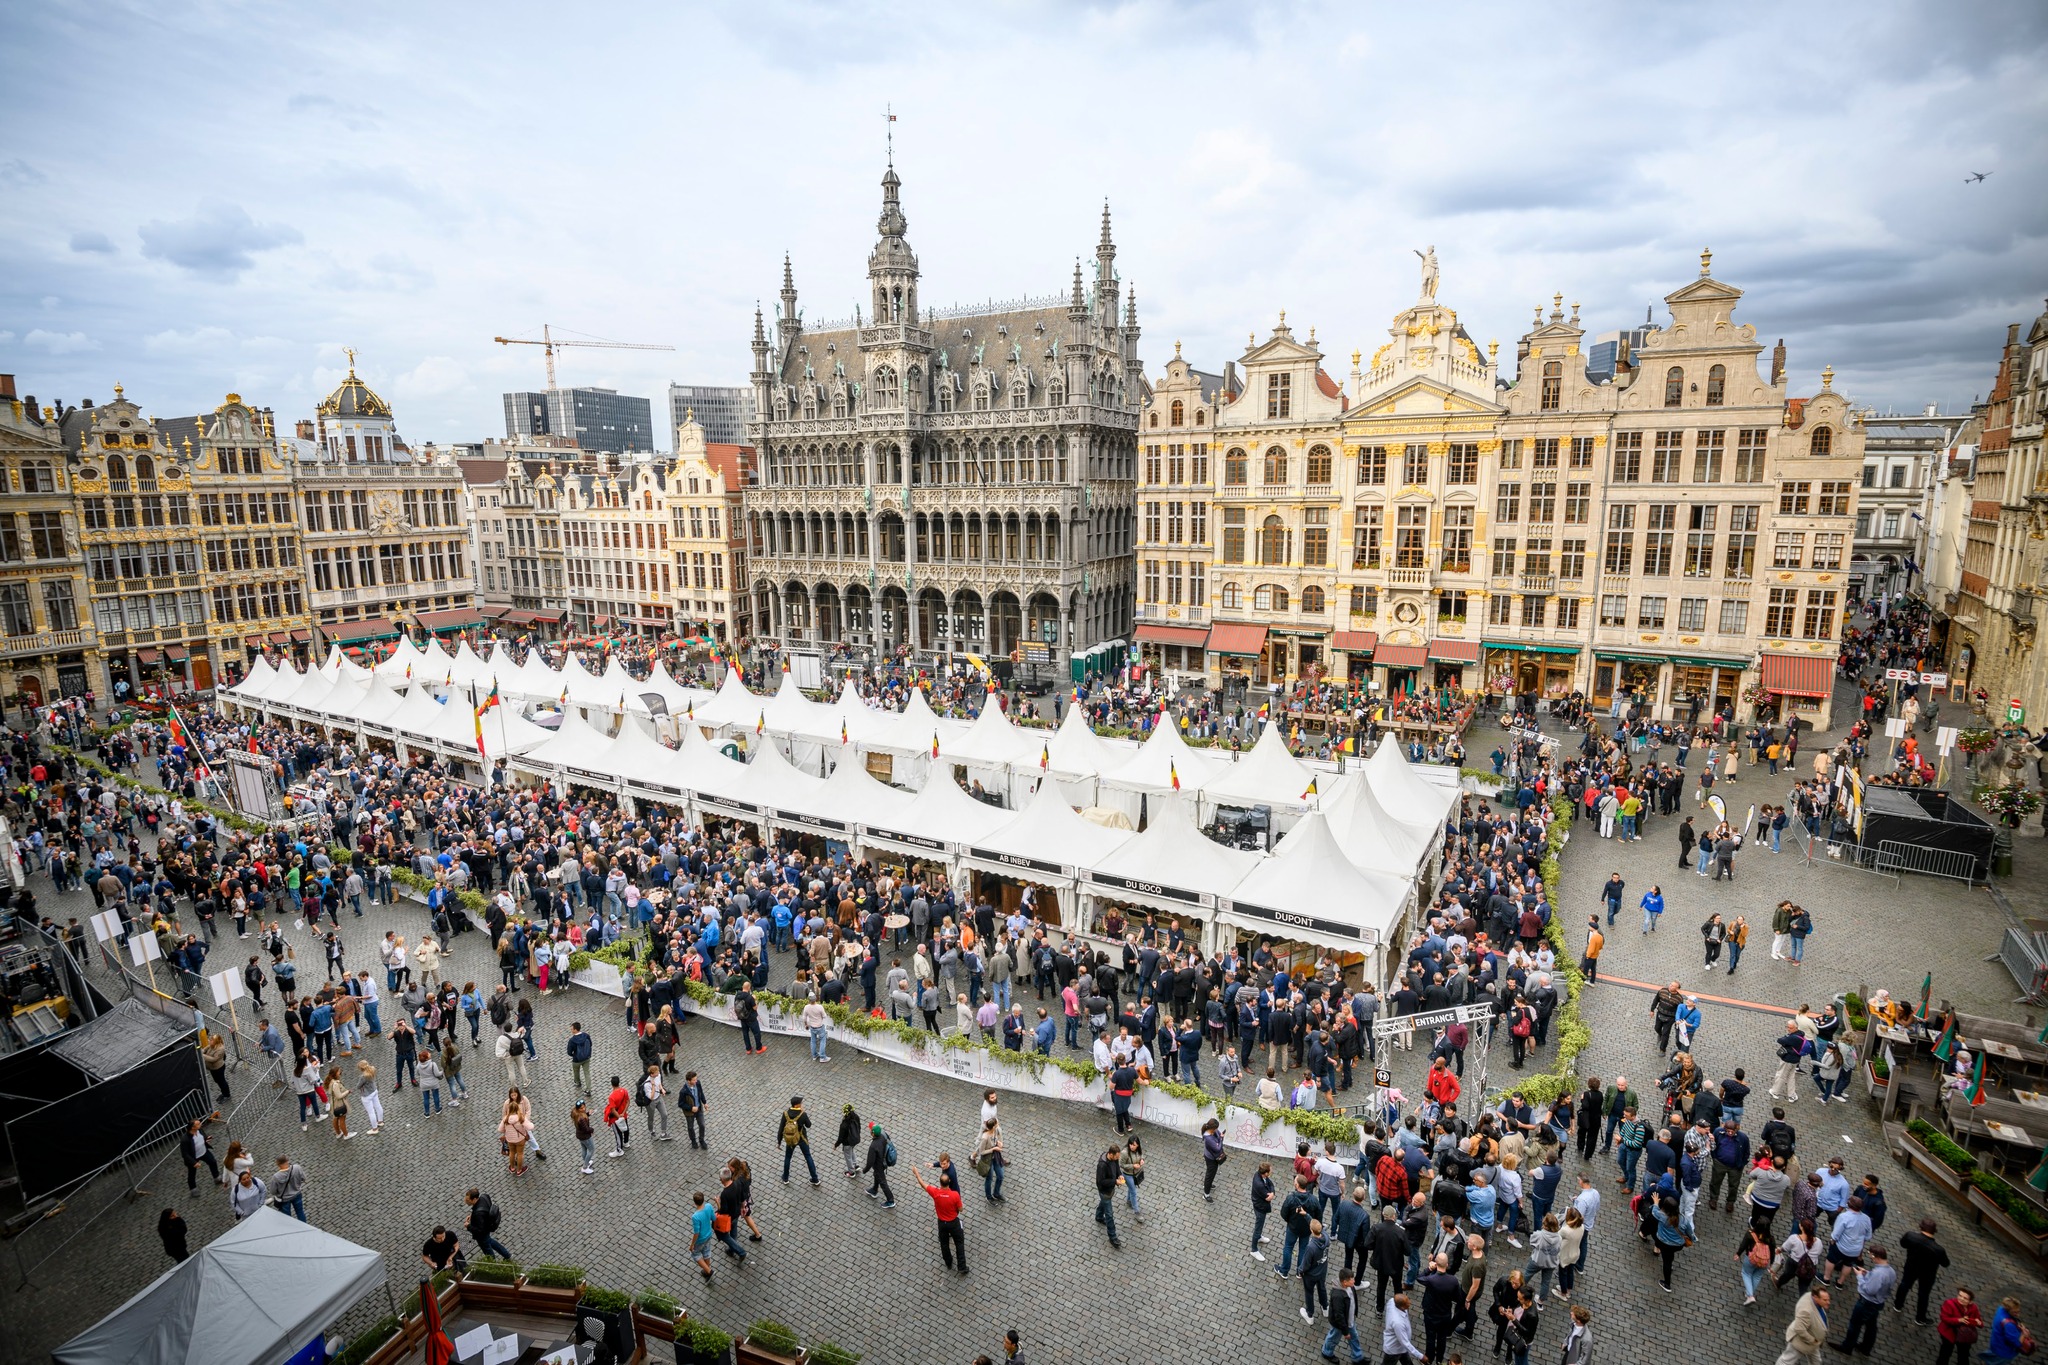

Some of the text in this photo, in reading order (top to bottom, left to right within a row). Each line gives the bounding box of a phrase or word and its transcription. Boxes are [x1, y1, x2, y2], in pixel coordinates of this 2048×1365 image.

[1523, 731, 1535, 739] EXIT
[713, 796, 740, 808] LINDEMANS
[799, 814, 821, 826] HUYGHE
[999, 854, 1031, 867] AB INBEV
[1125, 880, 1162, 894] DU BOCQ
[1275, 911, 1314, 927] DUPONT
[1415, 1012, 1456, 1028] ENTRANCE
